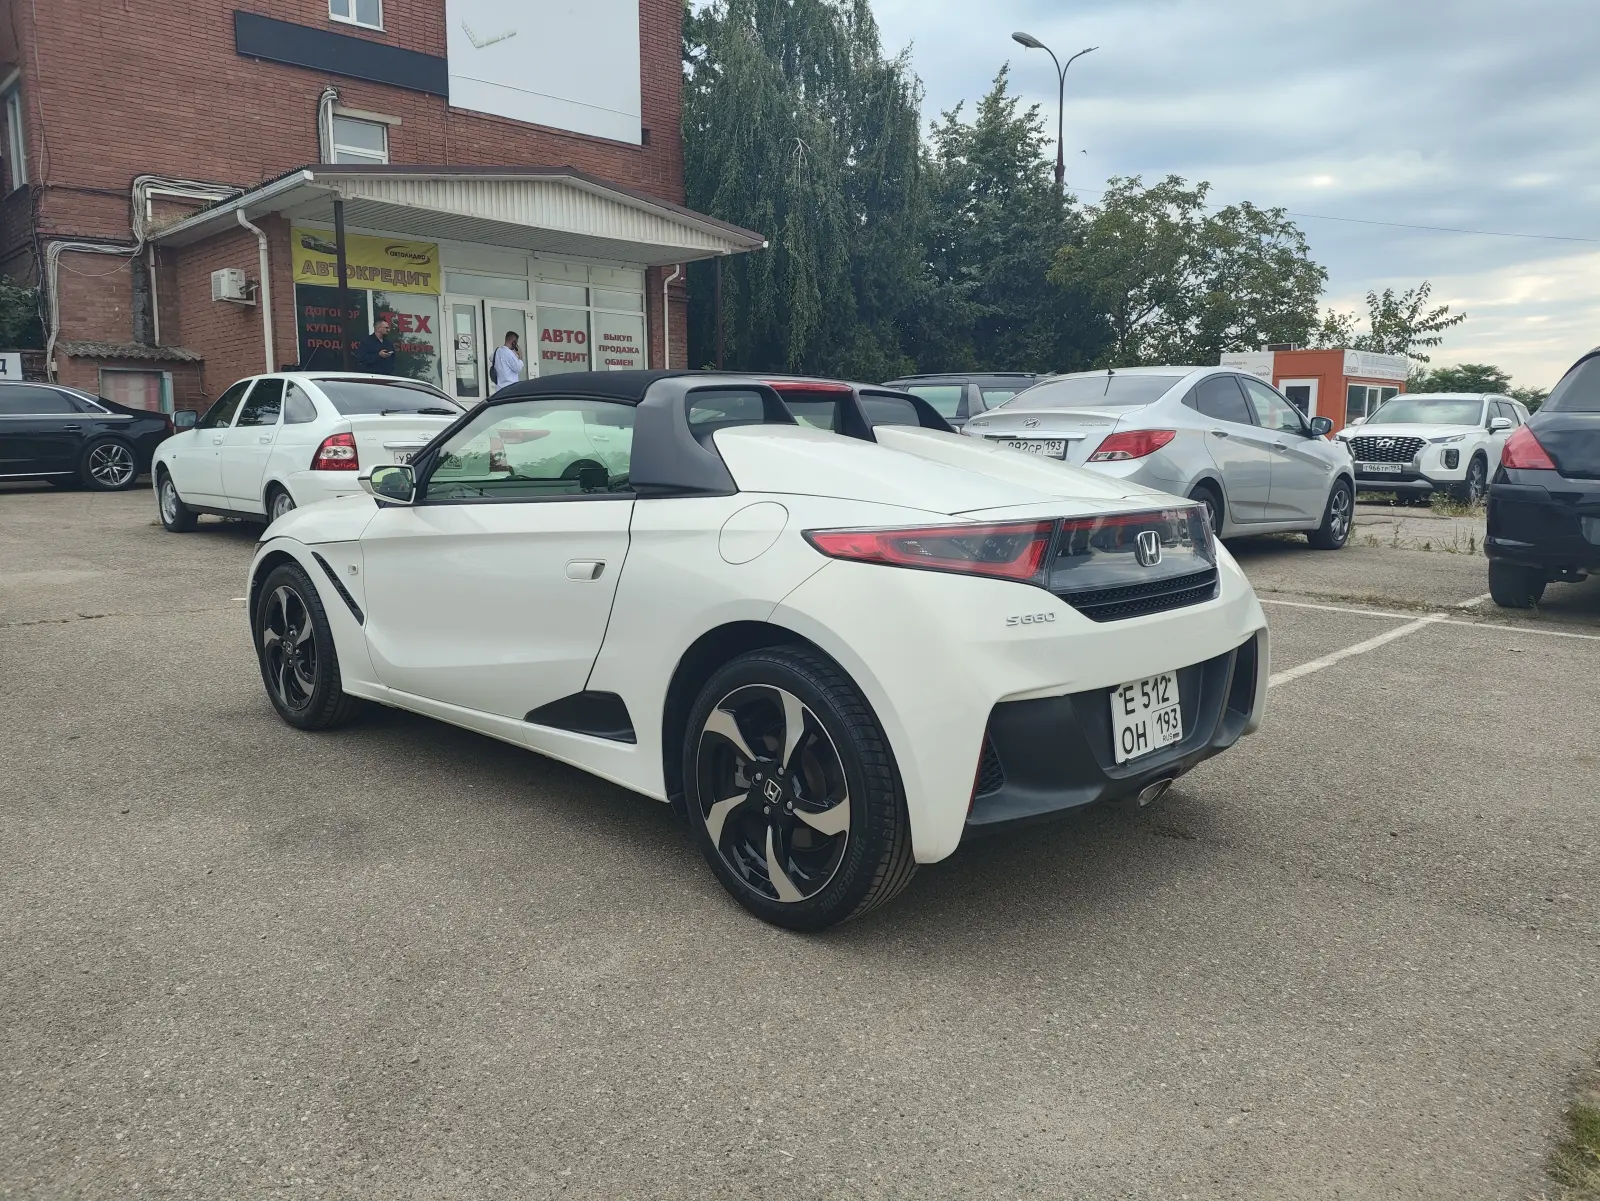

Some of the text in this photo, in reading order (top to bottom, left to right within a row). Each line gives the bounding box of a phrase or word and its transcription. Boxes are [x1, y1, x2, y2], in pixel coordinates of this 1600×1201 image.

[301, 259, 432, 287] АВТОКРЕДИТ
[380, 311, 433, 334] ТЕХ
[541, 329, 587, 344] АВТО
[603, 333, 633, 343] ВЫКУП
[599, 344, 640, 355] ПРОДАЖА
[542, 350, 588, 364] КРЕДИТ
[604, 358, 634, 367] ОБМЕН
[1045, 440, 1062, 451] 193
[1123, 675, 1170, 715] Е 512
[1122, 708, 1178, 754] ОН 193
